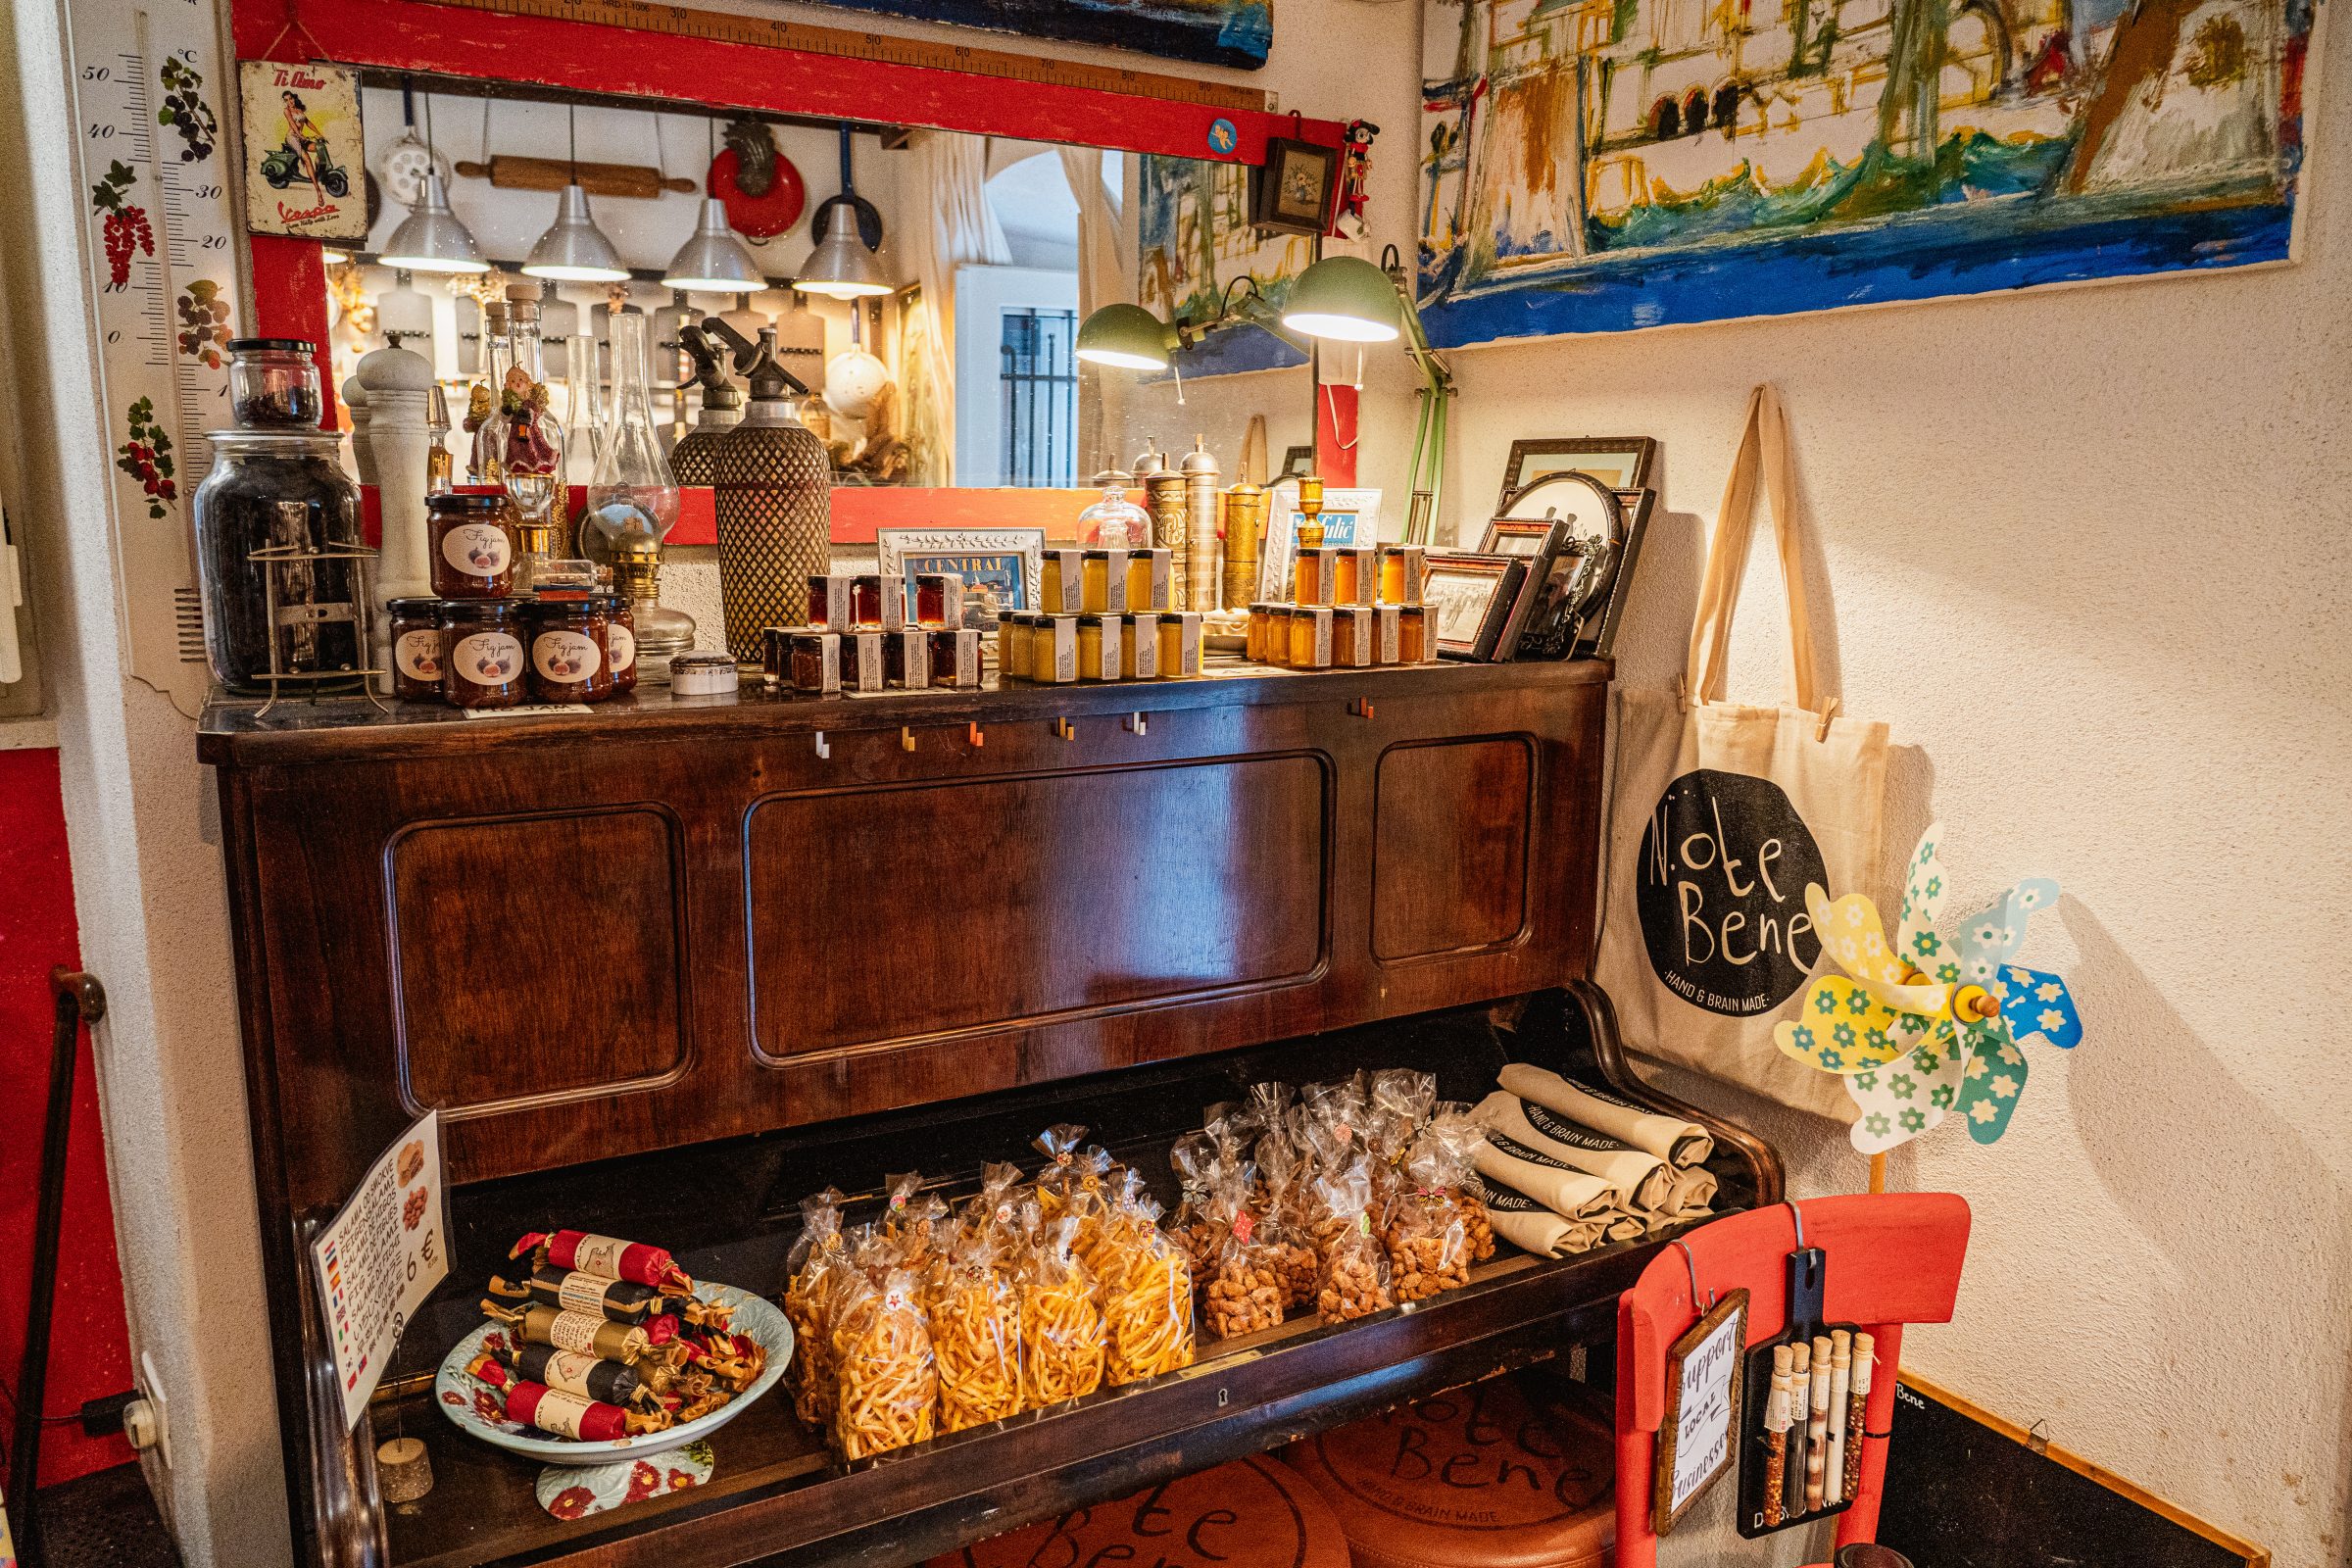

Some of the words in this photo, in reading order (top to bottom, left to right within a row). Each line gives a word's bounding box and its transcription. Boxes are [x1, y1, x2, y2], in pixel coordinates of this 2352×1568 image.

[770, 22, 787, 33] 40
[865, 34, 881, 46] 50
[955, 46, 970, 58] 60
[82, 66, 110, 81] 50
[1040, 58, 1055, 70] 70
[274, 69, 289, 86] Ti
[290, 71, 326, 90] Amo
[1121, 70, 1135, 81] 80
[87, 123, 115, 139] 40
[196, 184, 222, 199] 30
[277, 201, 340, 223] Vespa
[201, 235, 226, 250] 20
[103, 280, 128, 294] 10
[108, 330, 121, 343] 0
[218, 384, 228, 397] 1
[463, 529, 489, 549] Fig
[489, 535, 505, 549] jam
[924, 558, 1004, 573] CENTRAL
[407, 635, 431, 654] Fig
[468, 639, 496, 658] Fig
[496, 643, 515, 657] jam
[543, 637, 566, 657] Fig
[566, 643, 588, 656] jam
[611, 634, 626, 647] jam
[1678, 881, 1813, 976] Bene
[1696, 989, 1705, 1003] &
[1707, 992, 1740, 1011] BRAIN
[1741, 994, 1767, 1011] MADE
[1548, 1121, 1581, 1144] BRAIN
[1582, 1136, 1617, 1151] MADE
[339, 1205, 363, 1244] SALAMA
[370, 1158, 394, 1194] SMOKVE
[1495, 1195, 1530, 1208] MADE
[341, 1174, 395, 1258] FEIGENSALAMI
[344, 1231, 368, 1273] SALAMI
[368, 1216, 376, 1236] DE
[375, 1188, 397, 1217] HIGOS
[347, 1249, 369, 1290] SALAMI
[369, 1234, 377, 1253] DE
[375, 1202, 398, 1238] FIGUES
[407, 1250, 416, 1282] 6
[421, 1228, 434, 1261] €
[348, 1275, 366, 1306] FIG
[368, 1218, 399, 1277] SALAMI
[352, 1276, 375, 1323] SALAME
[375, 1264, 382, 1280] DI
[382, 1234, 401, 1267] FICHI
[1895, 1384, 1926, 1409] Bene
[1380, 1381, 1564, 1461] ote
[1685, 1392, 1716, 1440] LOCAL
[1392, 1427, 1601, 1511] Bene
[1131, 1478, 1238, 1561] te
[1405, 1502, 1451, 1517] BRAIN
[1456, 1511, 1498, 1522] MADE
